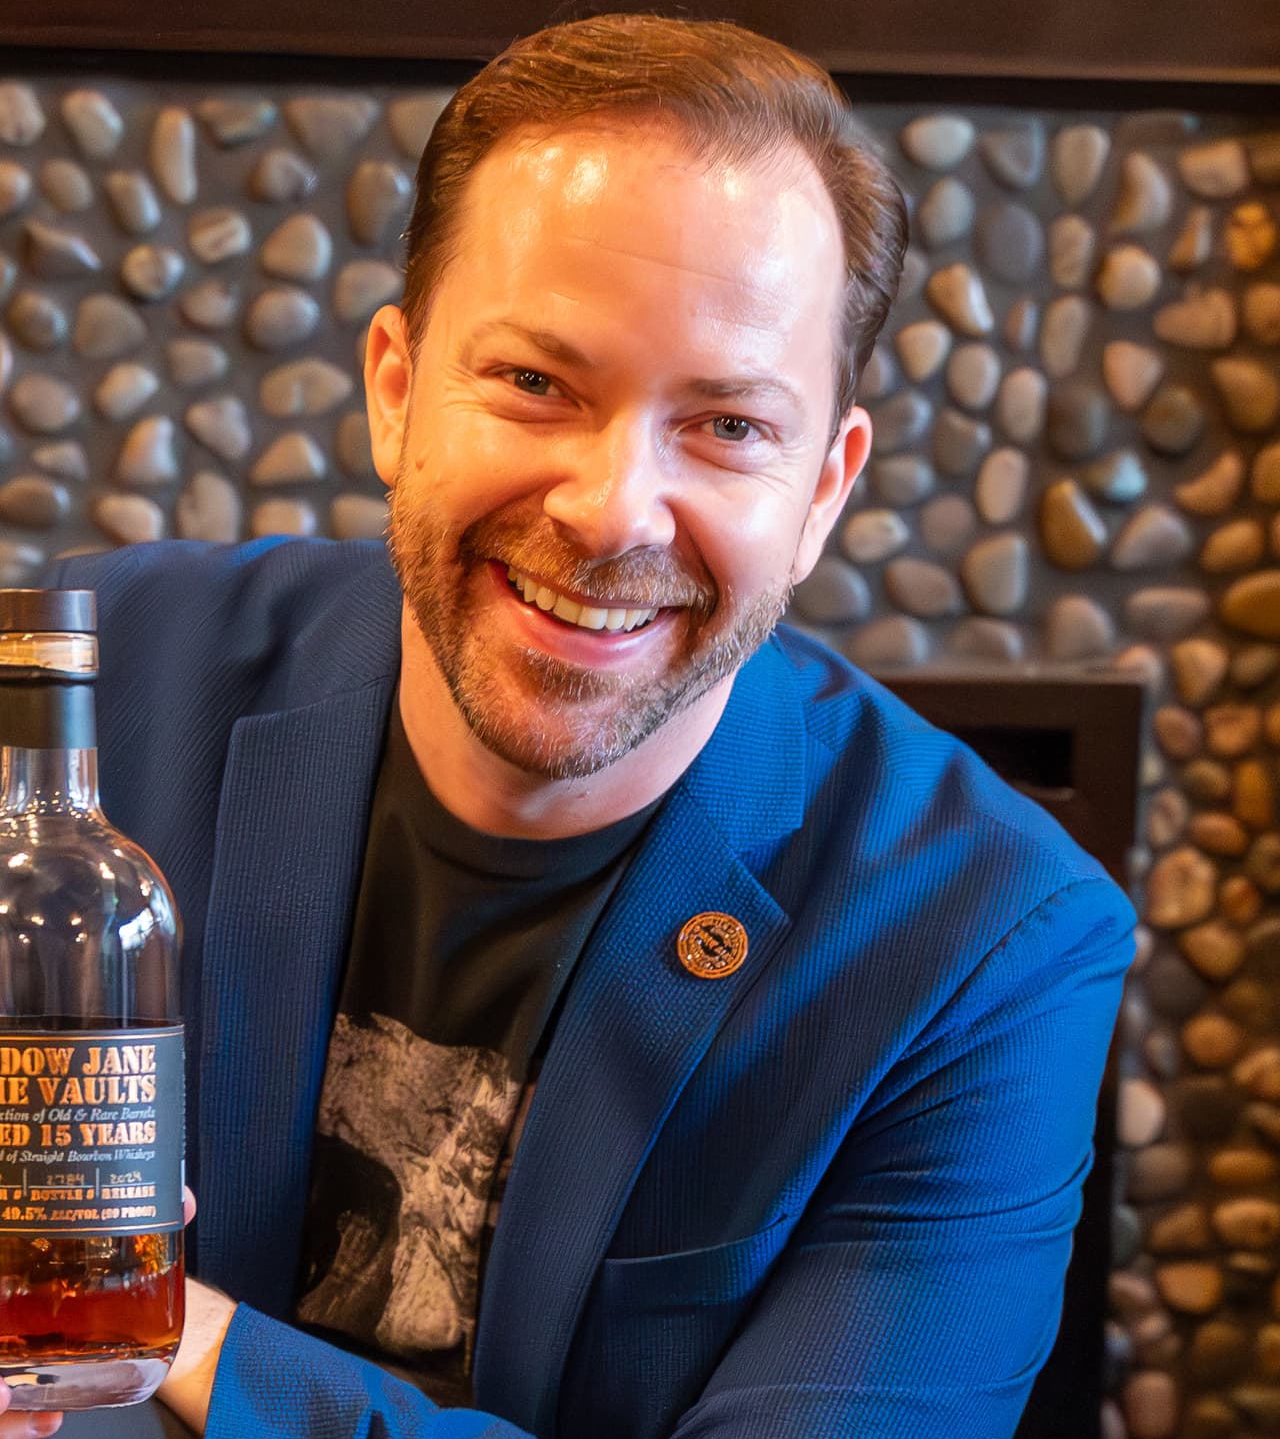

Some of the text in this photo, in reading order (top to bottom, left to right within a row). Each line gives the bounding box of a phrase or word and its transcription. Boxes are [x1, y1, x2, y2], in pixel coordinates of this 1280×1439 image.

[82, 1045, 157, 1075] JANE
[37, 1075, 157, 1106] VAULTS
[32, 1109, 45, 1123] of
[48, 1108, 70, 1121] Old
[74, 1108, 86, 1121] &
[91, 1108, 118, 1121] Rare
[120, 1107, 156, 1121] Barrels
[40, 1124, 71, 1146] 15
[79, 1121, 157, 1146] YEARS
[6, 1150, 18, 1163] of
[20, 1150, 64, 1164] Straight
[67, 1150, 112, 1163] Bourbon
[110, 1170, 143, 1184] 2024
[30, 1188, 83, 1201] BOTTLE
[101, 1185, 156, 1200] RELEASE
[2, 1206, 47, 1221] 49.5%
